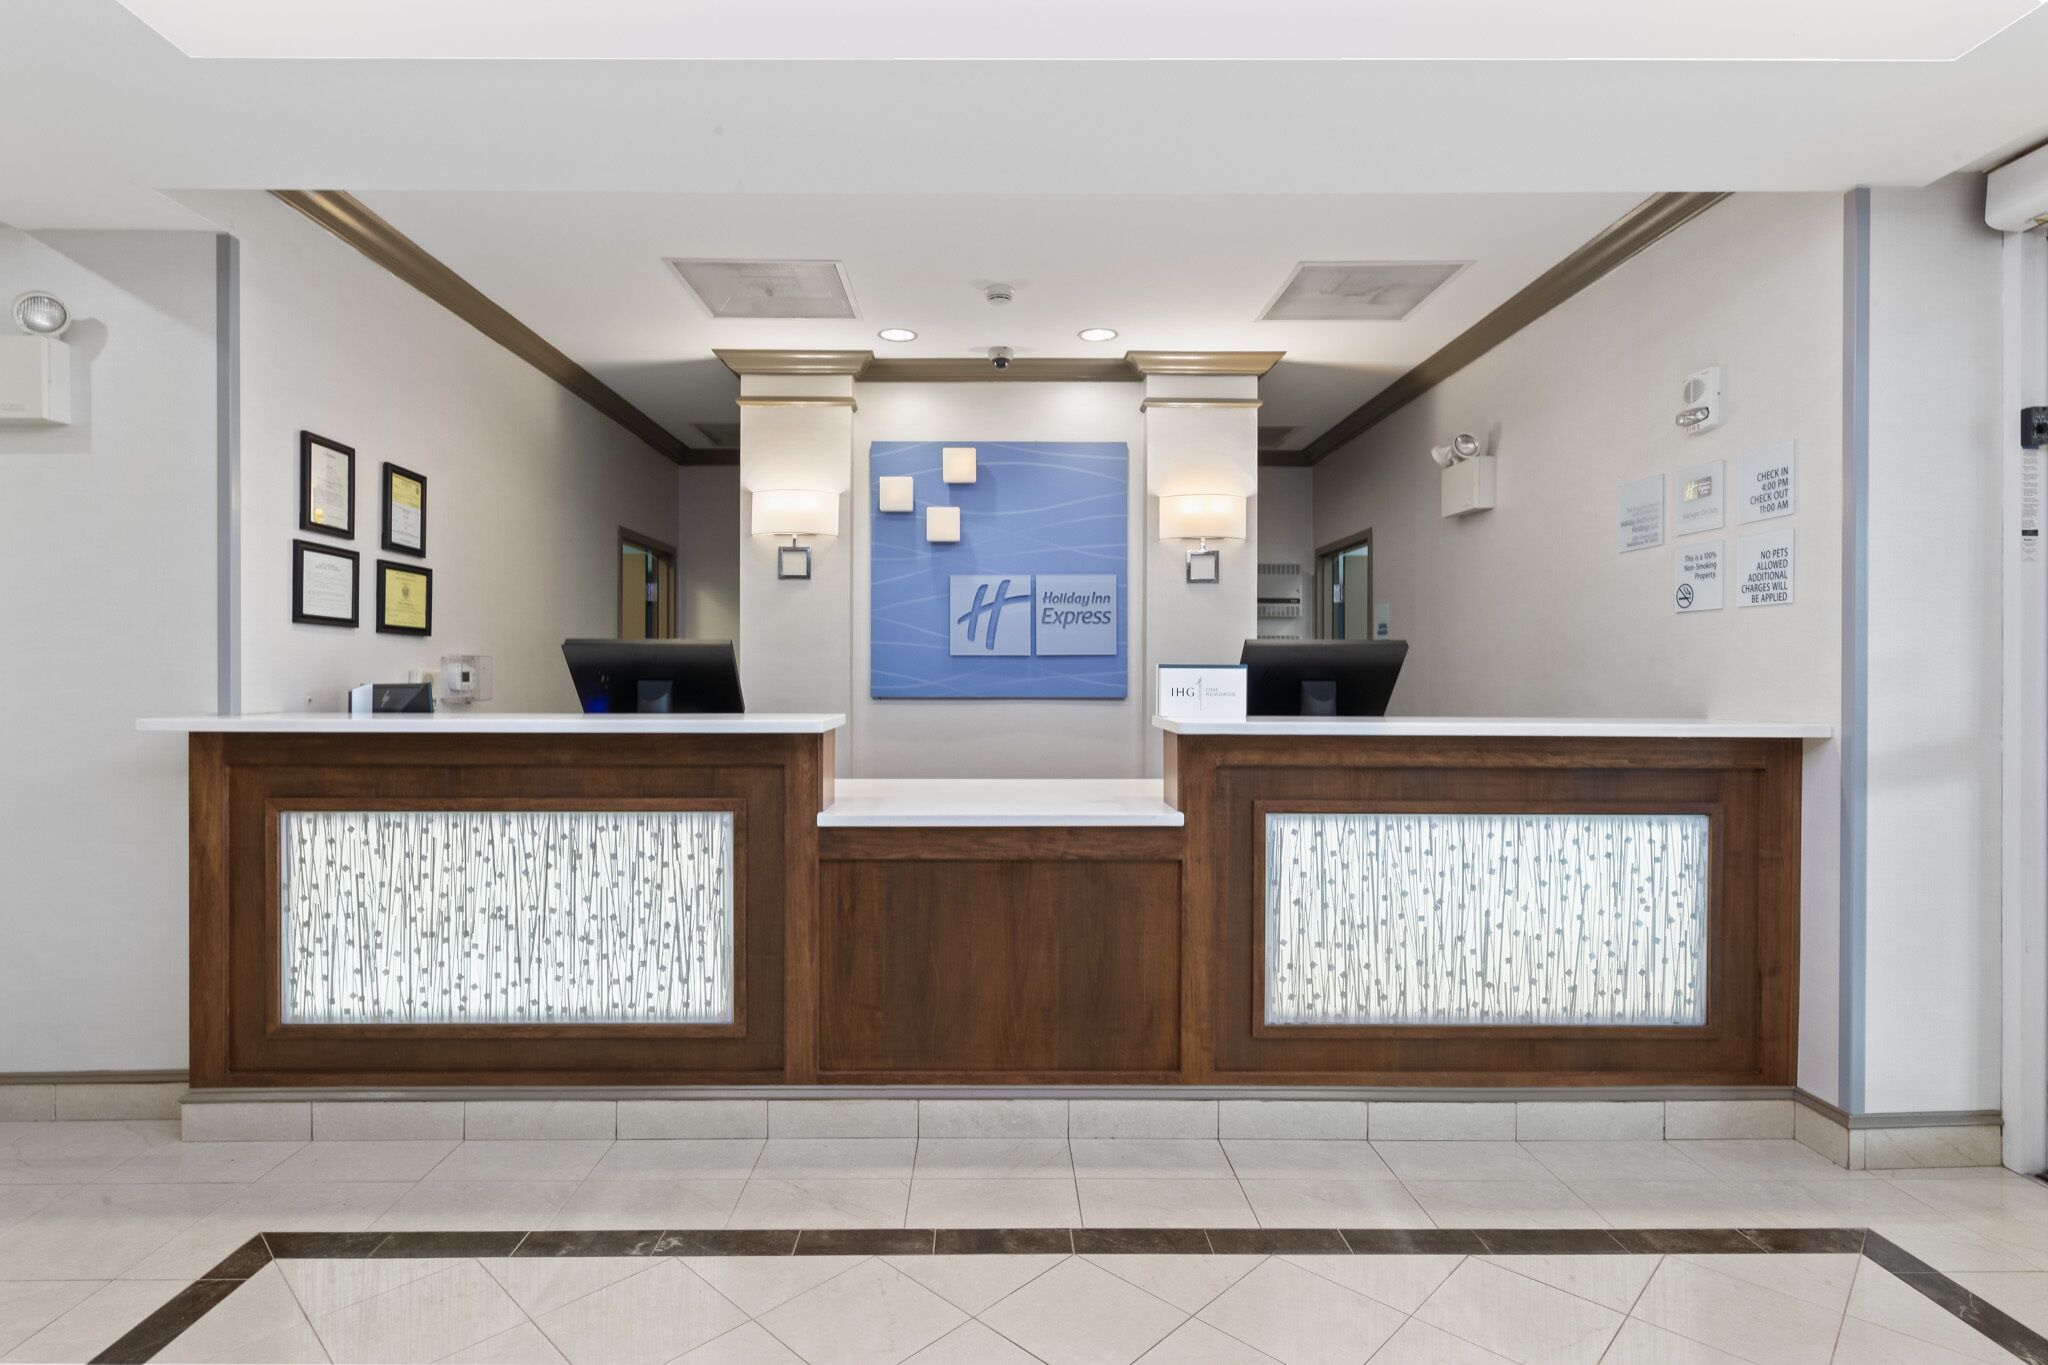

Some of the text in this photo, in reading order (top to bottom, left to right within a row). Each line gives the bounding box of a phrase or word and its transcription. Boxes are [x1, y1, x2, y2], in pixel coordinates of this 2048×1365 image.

[1757, 466, 1789, 482] CHECK IN
[1762, 477, 1789, 491] 4:00 PM
[1750, 488, 1789, 505] CHECK OUT
[1760, 500, 1789, 514] 11:00 AM
[1761, 547, 1788, 559] NO PETS
[1684, 561, 1717, 571] Non-Smoking
[1757, 559, 1788, 570] ALLOWED
[1748, 570, 1788, 582] ADDITIONAL
[1741, 581, 1788, 594] CHARGES WILL
[1042, 591, 1111, 607] Holiday Inn
[1752, 592, 1788, 603] BE APPLIED
[1041, 607, 1112, 629] Express
[1171, 687, 1195, 697] IHG
